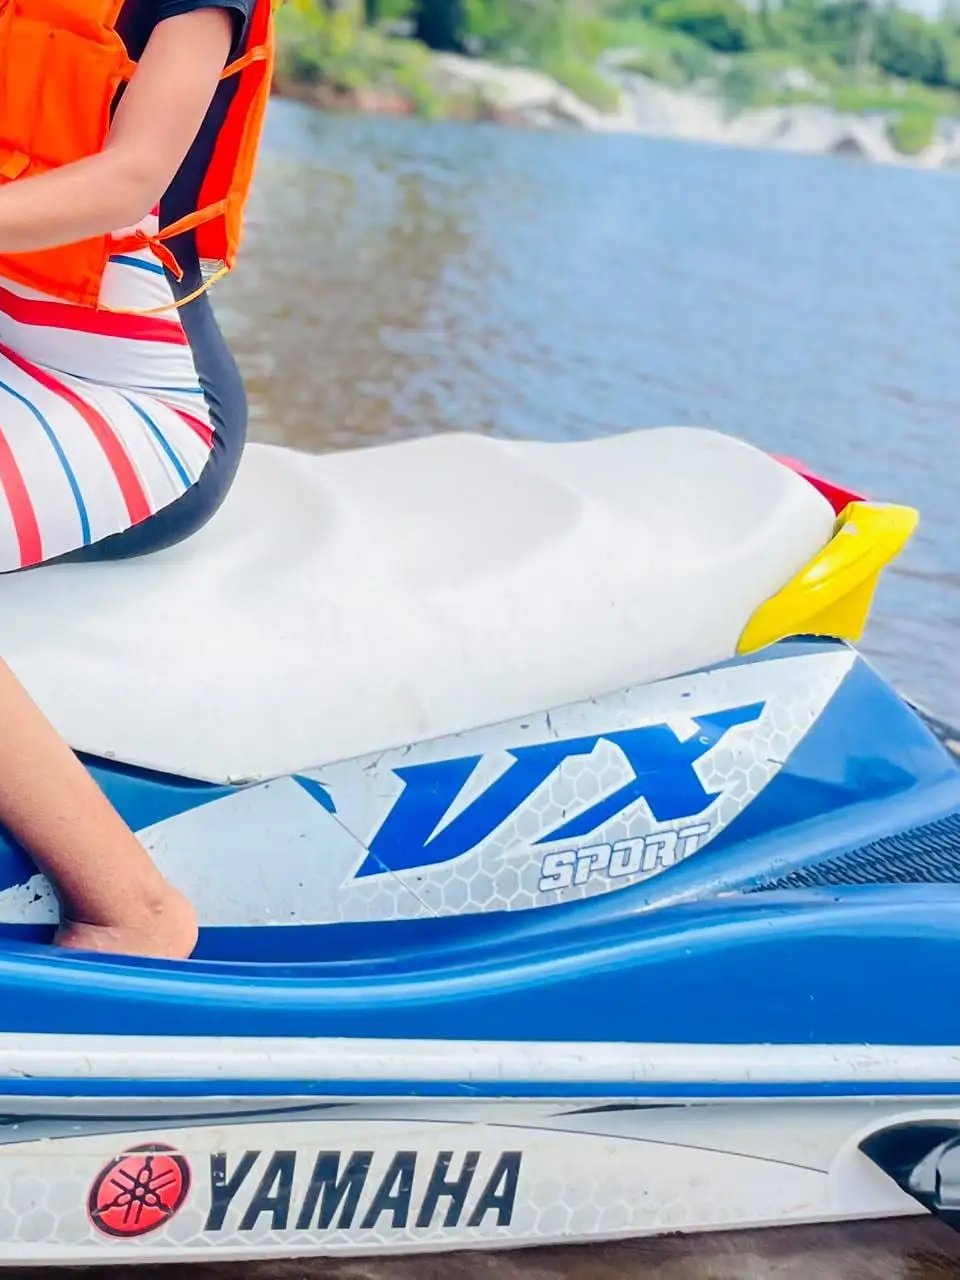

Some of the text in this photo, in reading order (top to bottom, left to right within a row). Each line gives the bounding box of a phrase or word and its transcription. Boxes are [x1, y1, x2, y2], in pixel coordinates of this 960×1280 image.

[356, 703, 765, 877] VX
[538, 823, 710, 892] SPORT
[204, 1150, 522, 1232] YAMAHA
